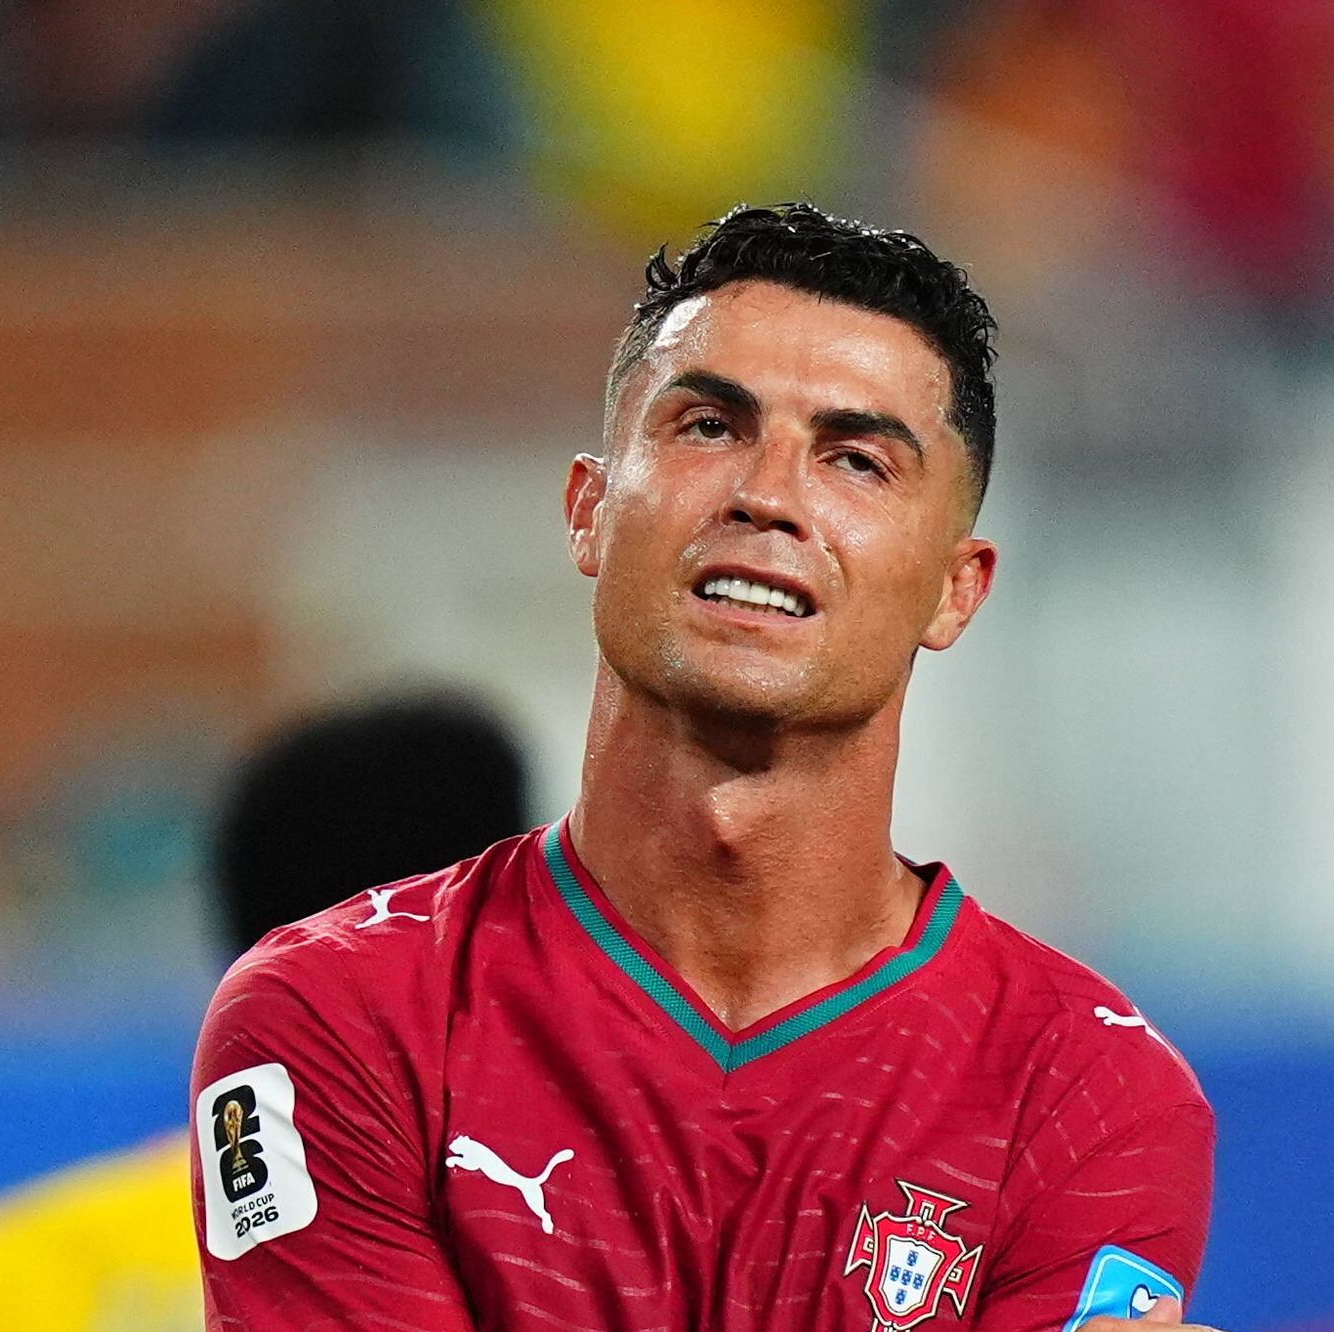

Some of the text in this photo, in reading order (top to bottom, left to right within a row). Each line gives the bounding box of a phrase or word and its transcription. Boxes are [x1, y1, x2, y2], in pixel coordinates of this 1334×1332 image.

[231, 1171, 256, 1192] FIFA
[256, 1193, 275, 1207] CUP
[234, 1206, 279, 1238] 2026
